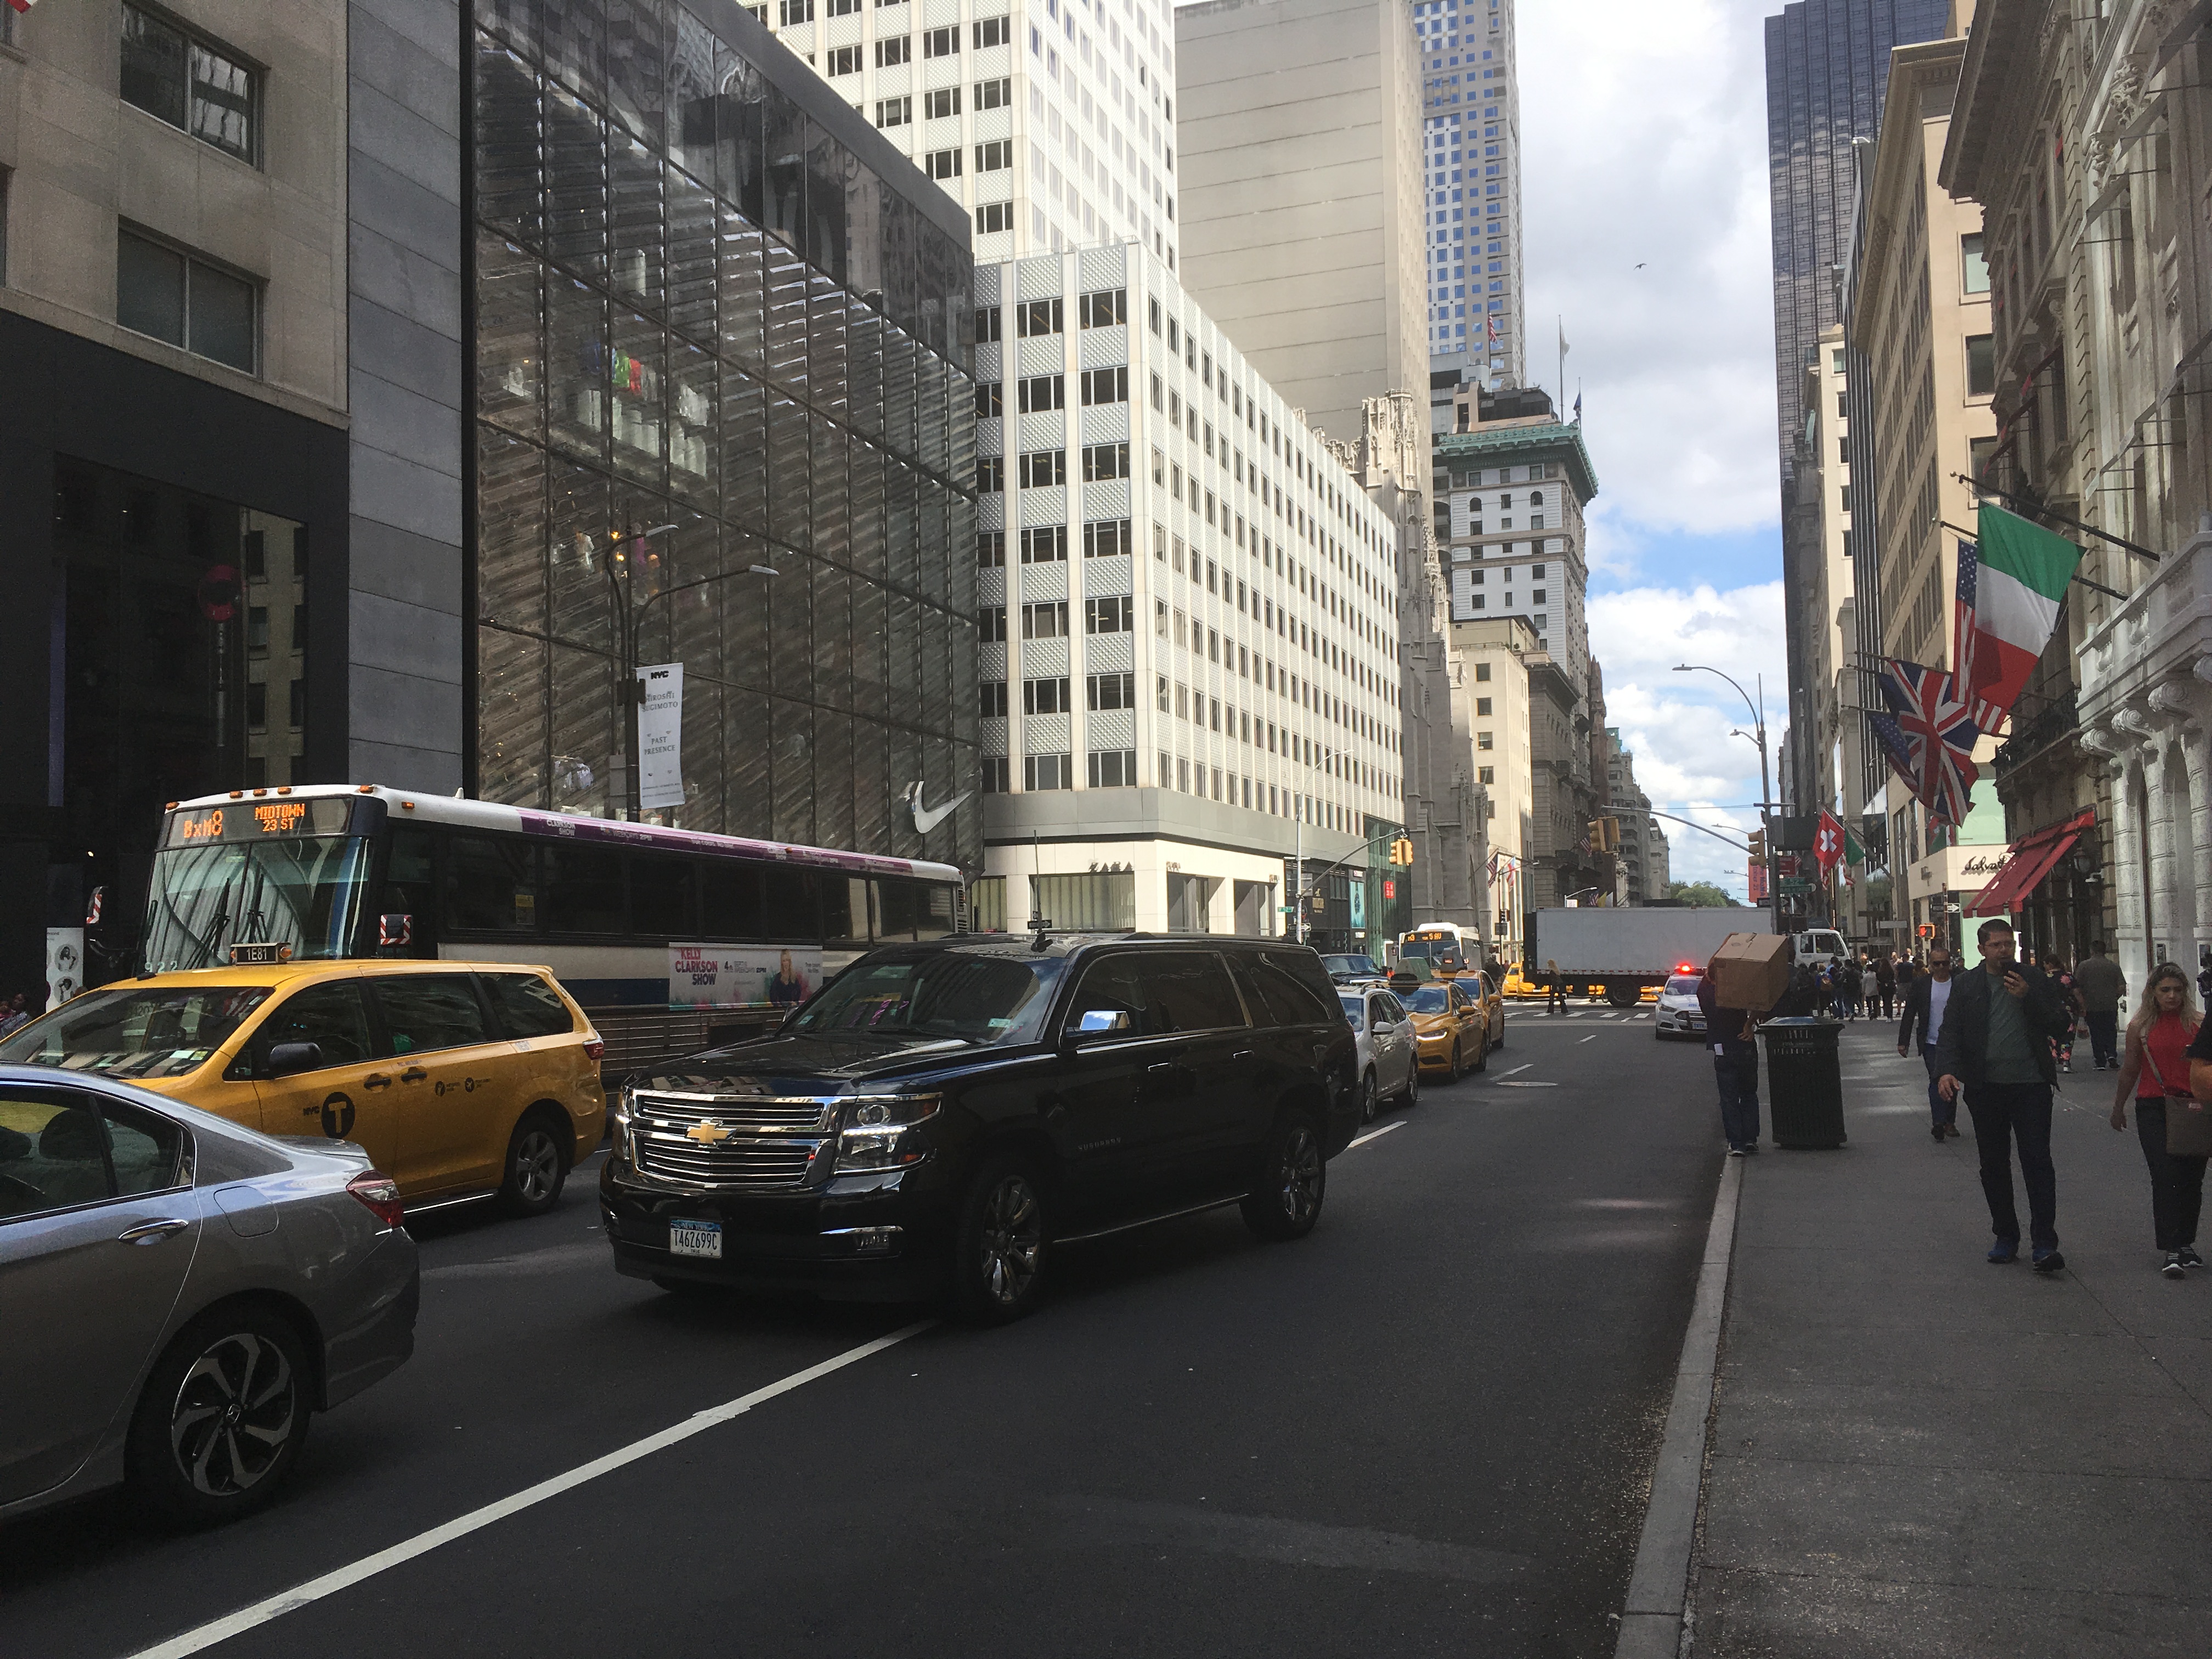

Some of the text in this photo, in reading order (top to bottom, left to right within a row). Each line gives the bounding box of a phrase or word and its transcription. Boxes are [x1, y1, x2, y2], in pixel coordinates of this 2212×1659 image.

[651, 670, 669, 680] NYC
[646, 692, 675, 702] HIROSHI
[641, 701, 678, 712] SUGIMOTO
[651, 736, 668, 744] PAST
[644, 744, 676, 755] PRESENCE
[255, 803, 305, 821] MIDTOWN
[184, 810, 223, 838] BxM8
[262, 817, 295, 832] 23 ST
[558, 827, 575, 836] SHOW
[1088, 861, 1133, 872] ZARA
[246, 947, 267, 961] 1E81
[680, 947, 702, 960] KELLY
[675, 960, 718, 973] CLARKSON
[692, 973, 716, 985] SHOW
[303, 1105, 320, 1116] NYC
[674, 1229, 717, 1250] T462699C
